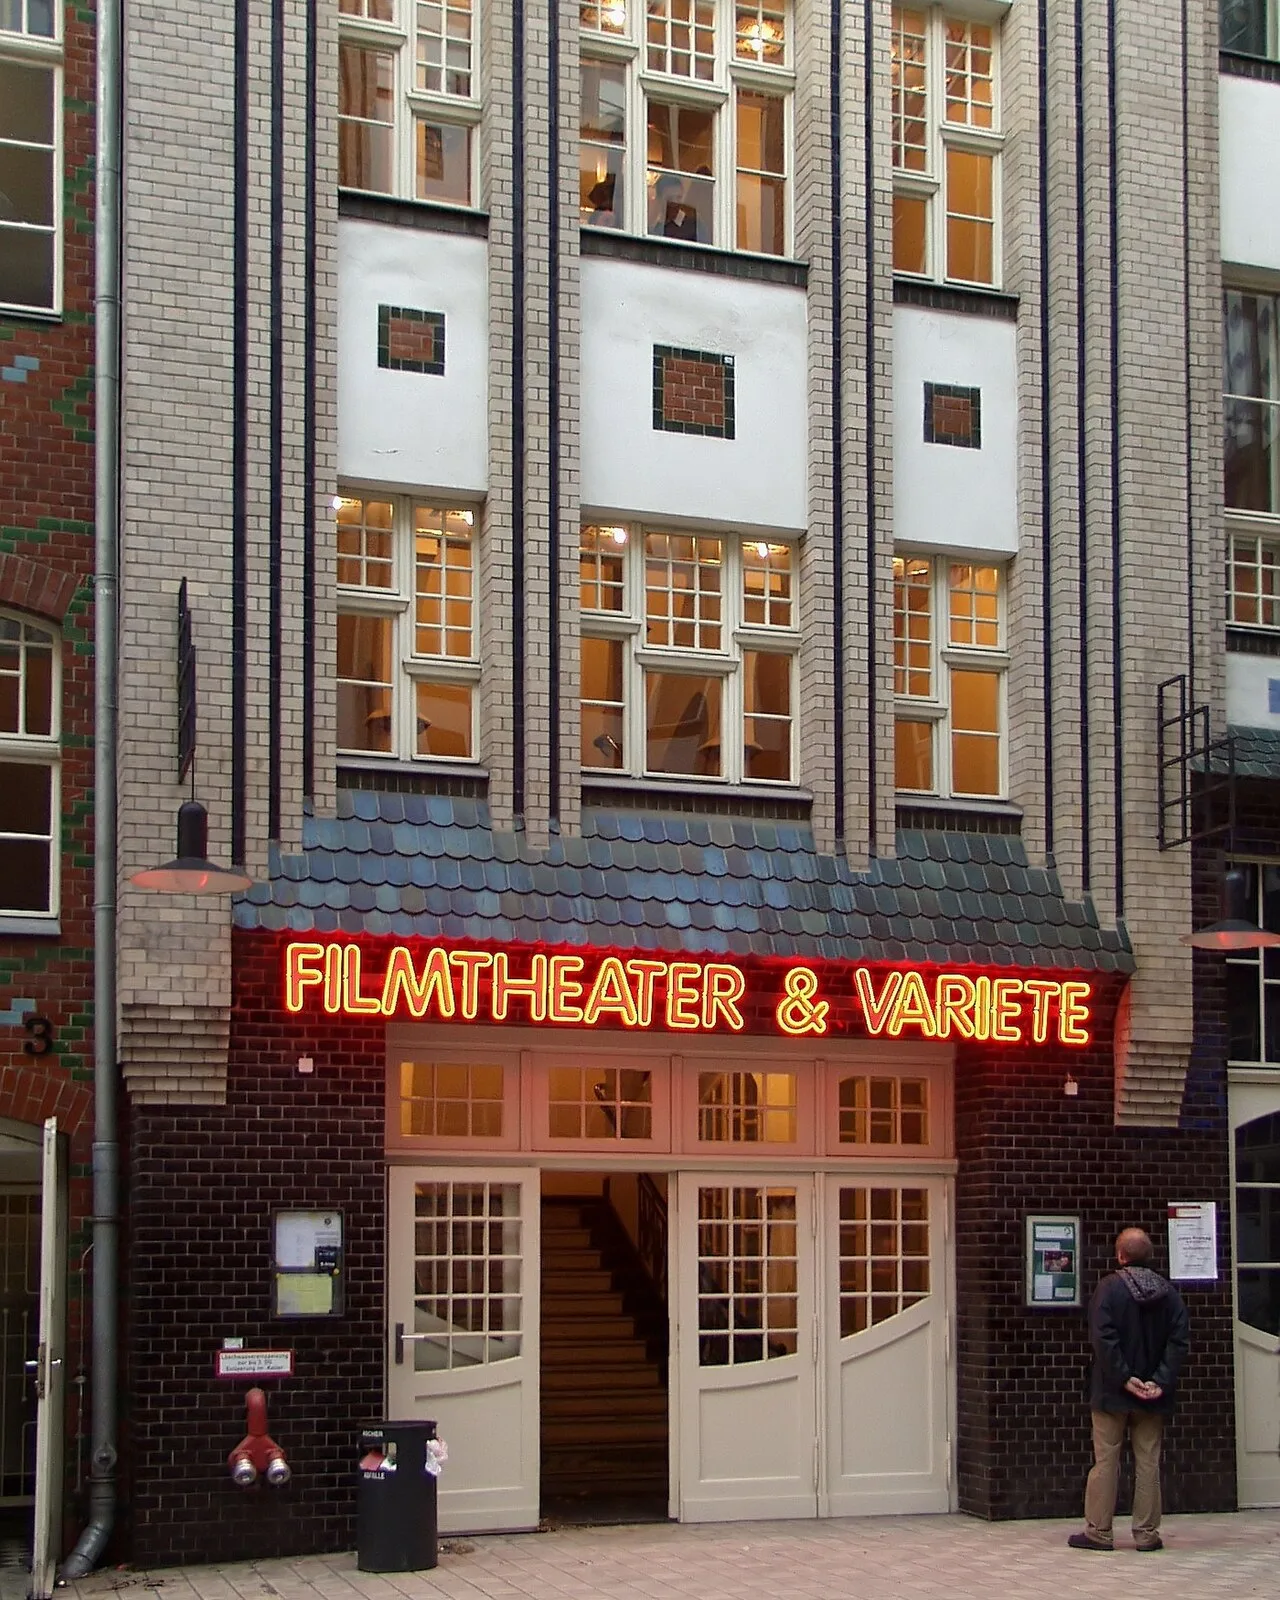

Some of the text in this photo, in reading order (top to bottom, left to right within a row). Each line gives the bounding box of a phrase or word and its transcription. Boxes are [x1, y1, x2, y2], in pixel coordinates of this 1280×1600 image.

[286, 942, 1091, 1044] FILMTHEATER & VARIETE
[24, 1017, 54, 1058] 3
